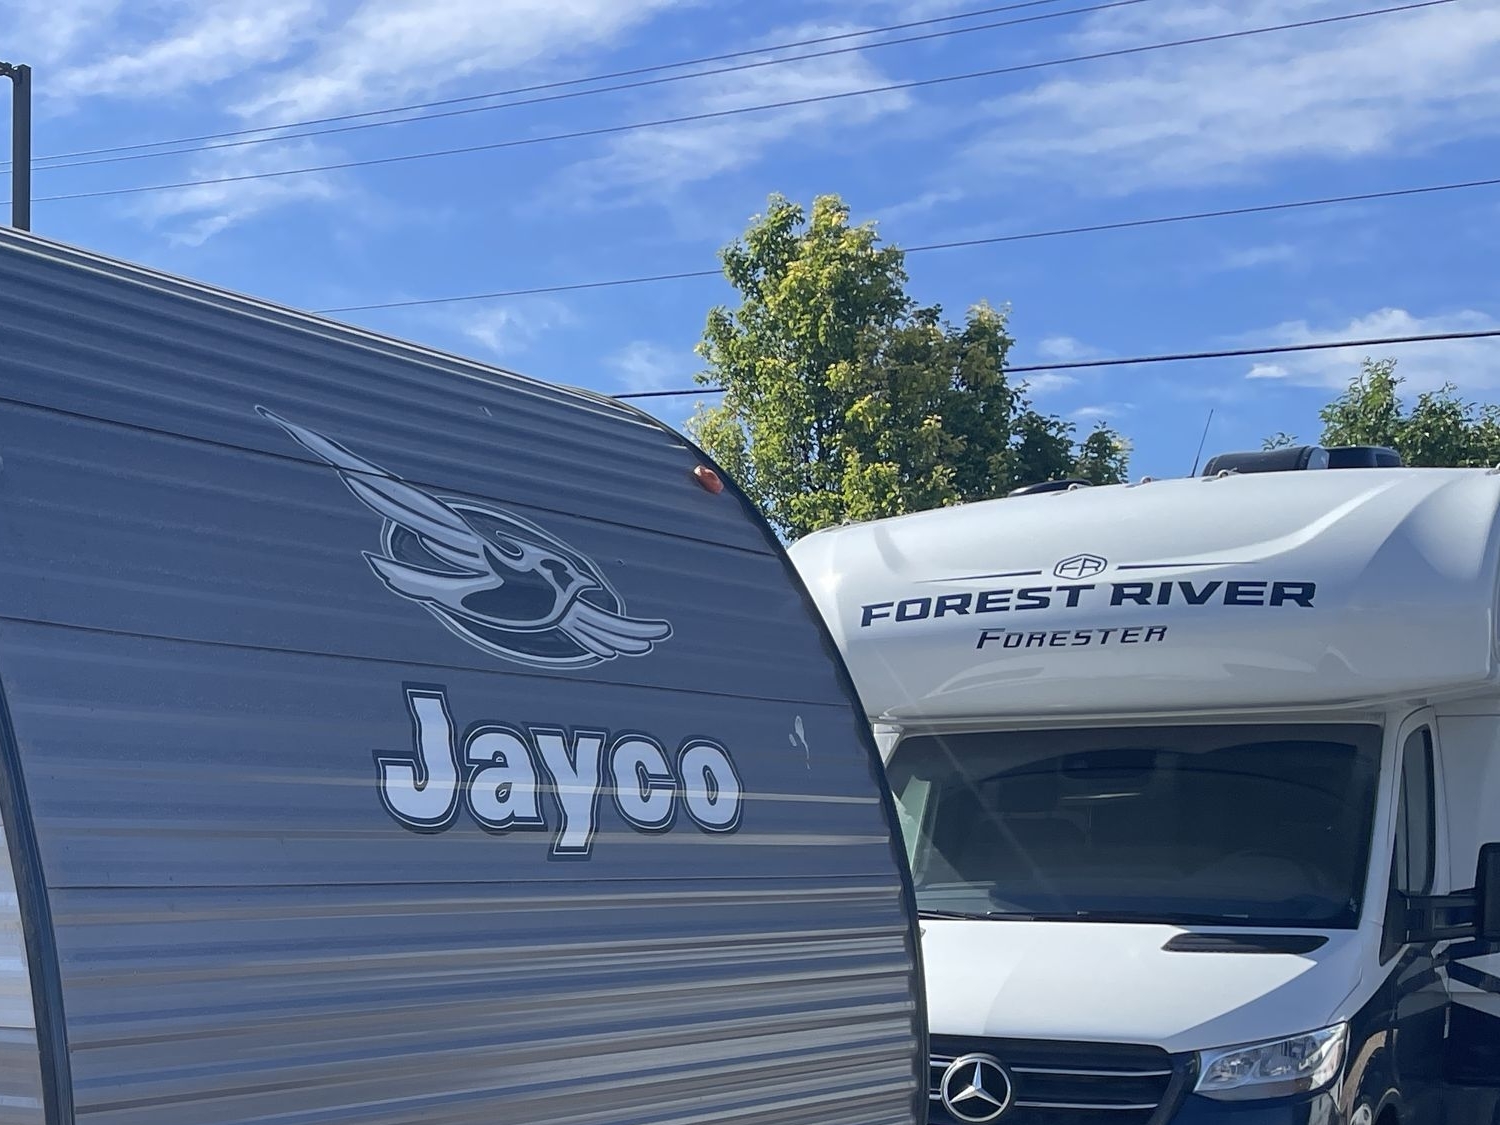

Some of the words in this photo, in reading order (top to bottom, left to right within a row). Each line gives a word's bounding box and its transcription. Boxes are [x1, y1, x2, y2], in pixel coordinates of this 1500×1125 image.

[861, 583, 1095, 627] FOREST
[1109, 581, 1316, 609] RIVER
[375, 684, 743, 860] Jayco
